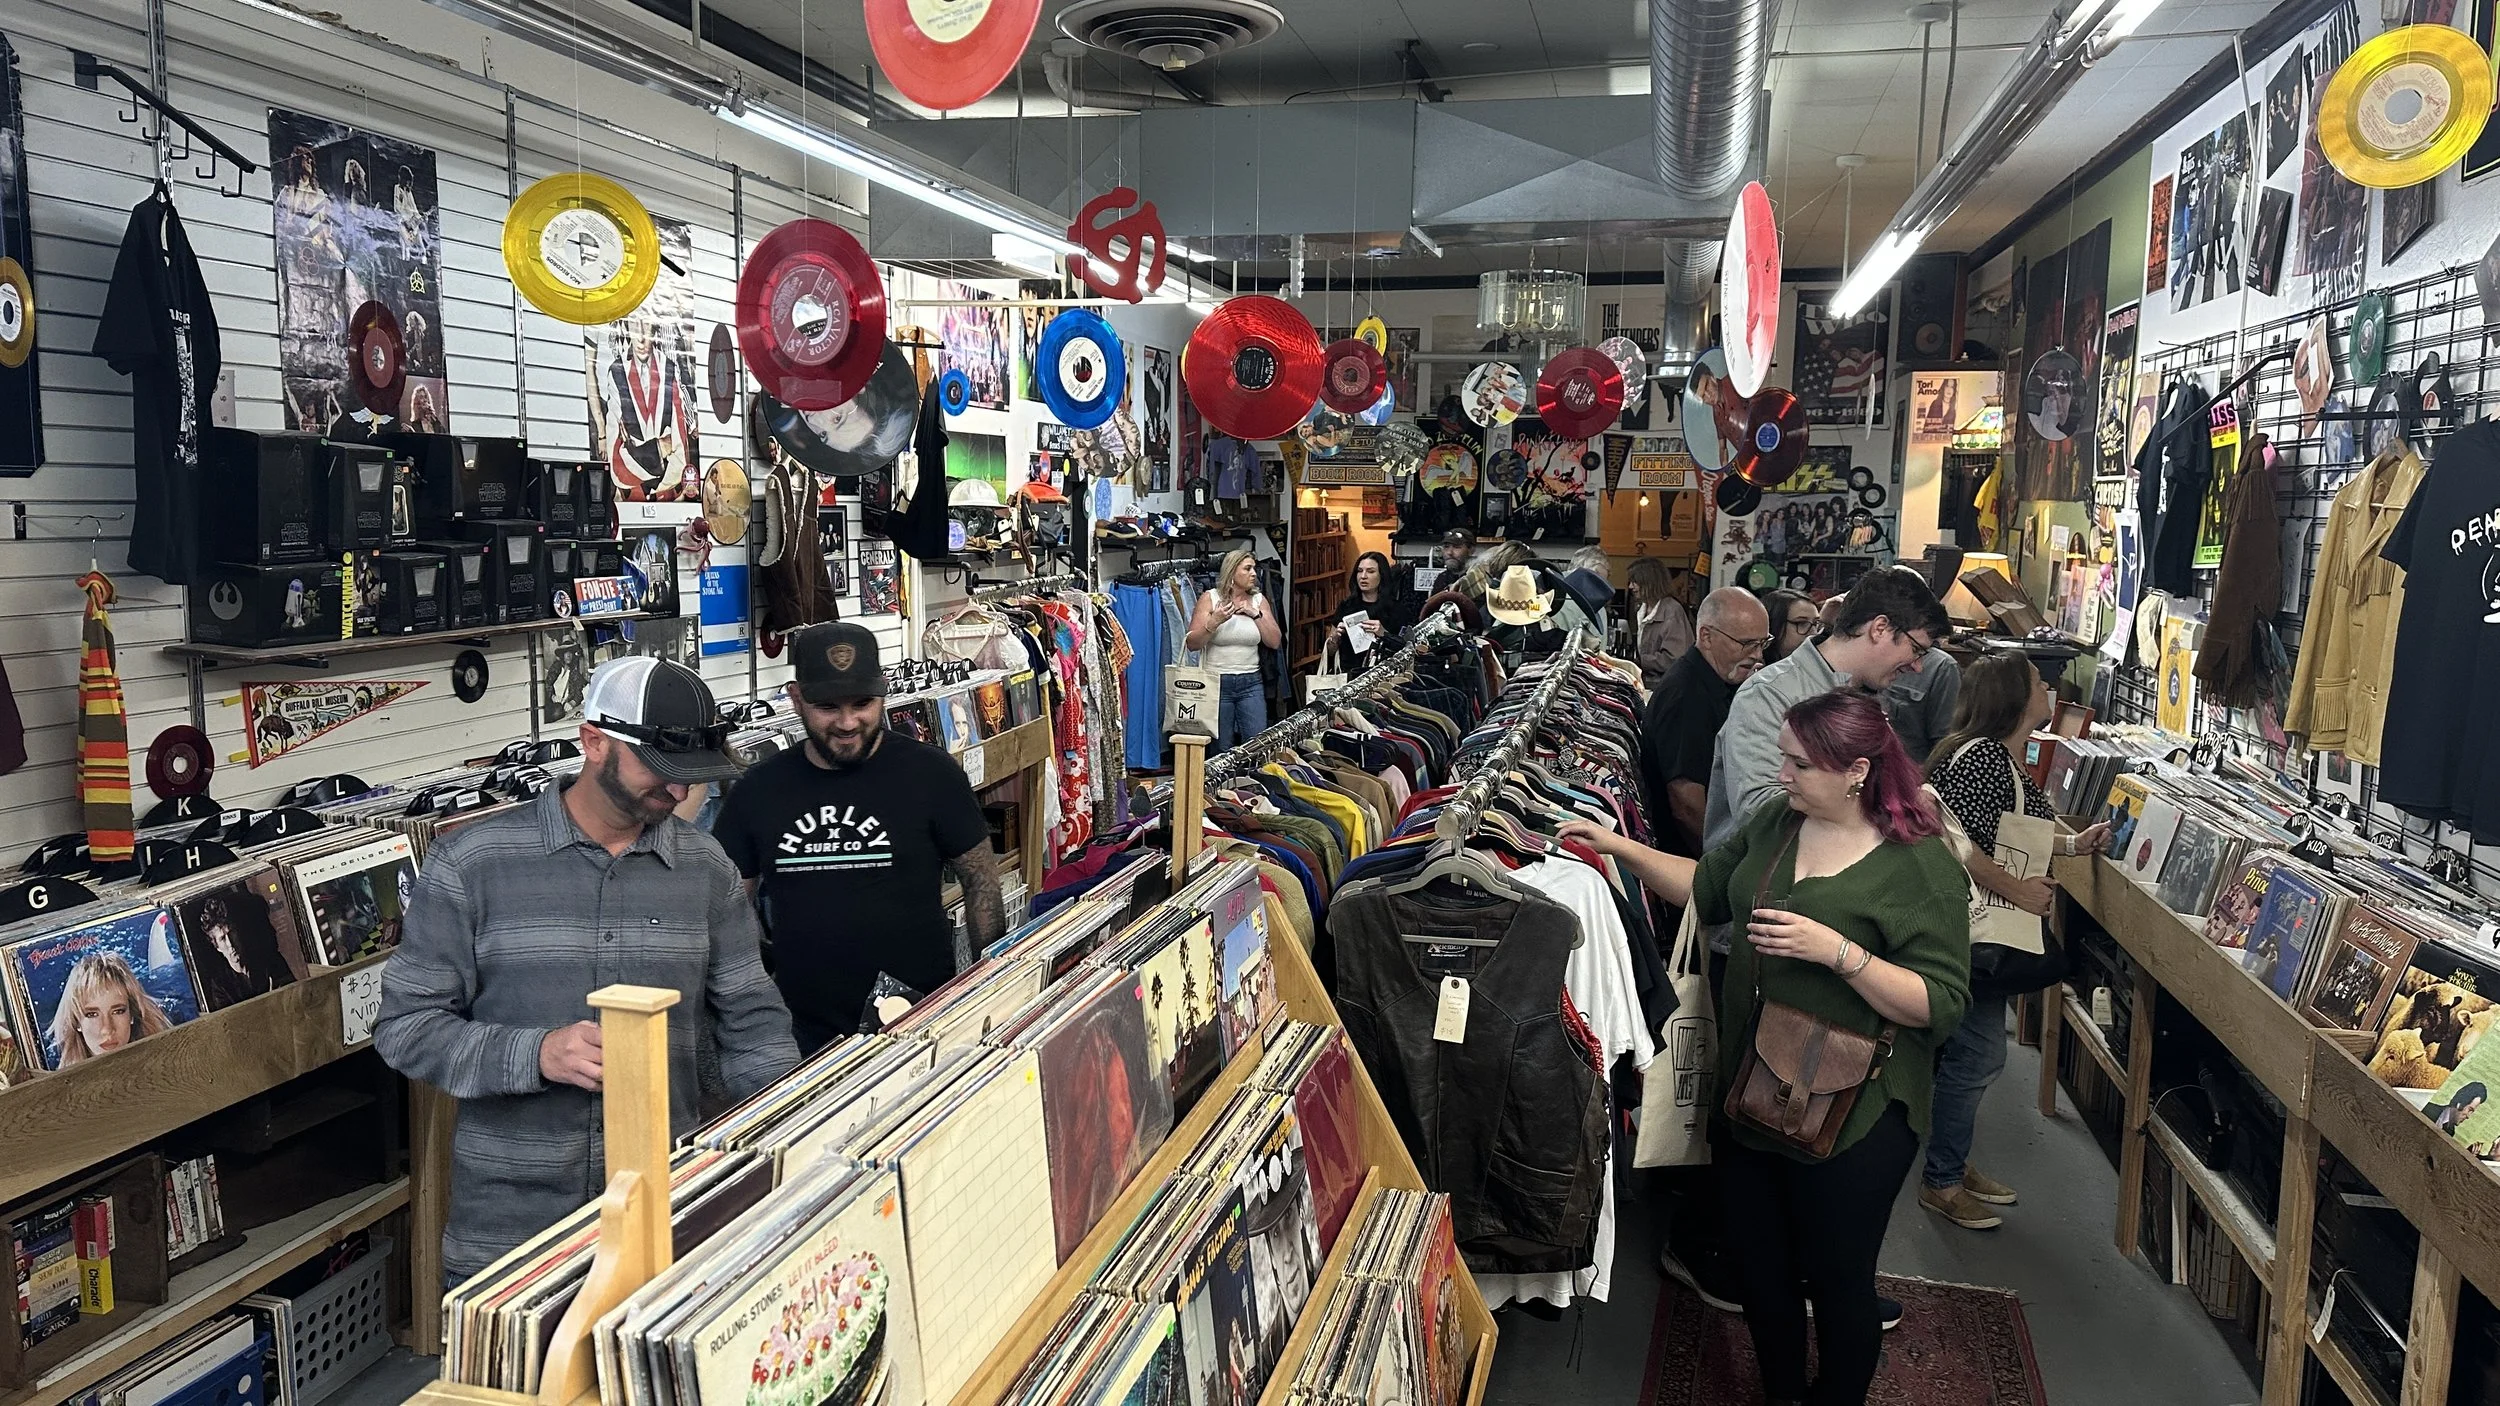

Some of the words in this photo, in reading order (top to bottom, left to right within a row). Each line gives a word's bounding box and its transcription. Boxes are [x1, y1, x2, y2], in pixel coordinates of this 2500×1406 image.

[832, 300, 841, 324] RCA
[1602, 303, 1620, 328] THE
[808, 328, 841, 356] VICTOR
[1265, 357, 1274, 384] STEREO
[1917, 380, 1934, 389] Tori
[1633, 456, 1693, 469] FITTING
[1311, 468, 1345, 481] BOOK
[1347, 468, 1384, 481] ROOM
[1642, 472, 1682, 484] ROOM
[479, 489, 506, 501] WARS
[1699, 470, 1719, 505] Oregon
[2096, 482, 2125, 505] CURTISS
[281, 530, 308, 542] WARS
[860, 549, 896, 566] GENERALS
[510, 581, 535, 593] WARS
[581, 579, 616, 600] FONZIE
[341, 566, 353, 640] WATCHMEN
[580, 602, 589, 612] for
[589, 600, 617, 613] PRESIDENT
[739, 625, 745, 635] R
[285, 698, 310, 713] BUFFALO
[311, 697, 324, 708] BILL
[325, 693, 349, 706] MUSEUM
[892, 709, 912, 724] STYX
[550, 742, 561, 759] M
[2195, 750, 2213, 767] RAP
[2134, 762, 2147, 773] TEN
[336, 778, 346, 797] L
[177, 797, 192, 817] K
[276, 814, 287, 835] J
[778, 805, 891, 854] HURLEY
[2291, 814, 2312, 834] WORLD
[804, 842, 840, 853] SURF
[843, 841, 862, 851] CO
[2306, 838, 2327, 855] KIDS
[2371, 834, 2394, 849] OLDIES
[146, 845, 152, 865] I
[186, 846, 200, 869] H
[302, 868, 325, 878] THE
[341, 853, 374, 866] GEILS
[28, 885, 49, 910] G
[2348, 916, 2360, 934] We
[2379, 933, 2405, 960] World
[27, 944, 64, 970] Great
[65, 933, 100, 952] White
[788, 1273, 801, 1288] LET
[801, 1262, 813, 1277] IT
[814, 1236, 839, 1265] BLEED
[1177, 1255, 1205, 1312] COSMO'S
[709, 1314, 748, 1357] ROLLING
[750, 1283, 783, 1321] STONES
